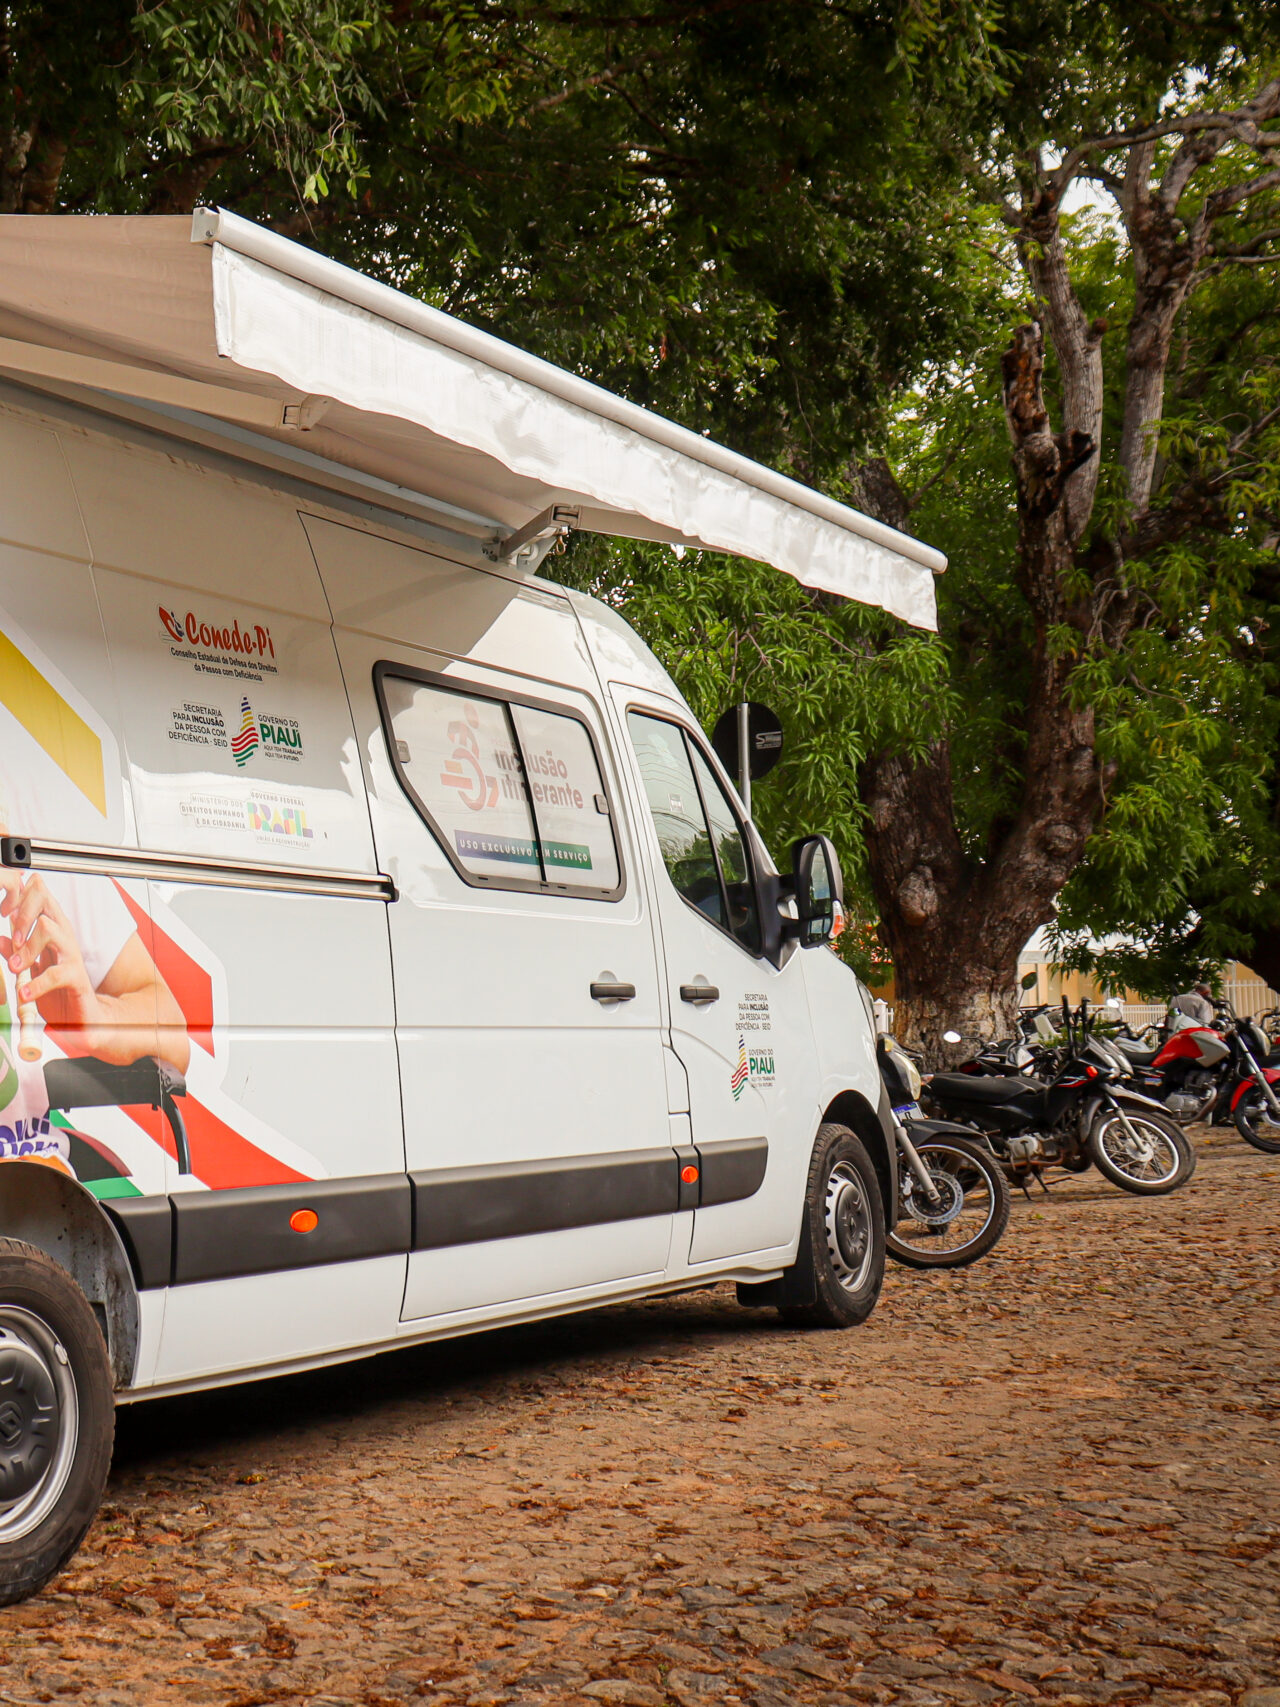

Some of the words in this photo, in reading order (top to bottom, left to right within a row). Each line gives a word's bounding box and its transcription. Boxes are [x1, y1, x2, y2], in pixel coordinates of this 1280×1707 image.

[185, 612, 275, 659] Conede-Pi
[170, 647, 197, 660] Conselho
[197, 651, 221, 664] Estadual
[221, 656, 229, 665] de
[229, 657, 247, 668] Defesa
[248, 661, 257, 670] dos
[258, 662, 278, 673] Direitos
[194, 663, 202, 671] da
[202, 664, 221, 675] Pessoa
[222, 668, 234, 677] com
[234, 668, 263, 682] Deficiência
[183, 703, 223, 718] SECRETARIA
[172, 712, 191, 722] PARA
[191, 715, 225, 728] INCLUSÃO
[257, 714, 288, 726] GOVERNO
[289, 719, 299, 728] DO
[174, 722, 185, 731] DA
[185, 723, 211, 735] PESSOA
[211, 728, 227, 738] COM
[168, 731, 209, 745] DEFICIÊNCIA
[213, 739, 228, 748] SEID
[246, 802, 314, 838] BRASIL
[460, 840, 478, 850] USO
[482, 842, 532, 857] EXCLUSIVO
[553, 850, 588, 863] SERVIÇO
